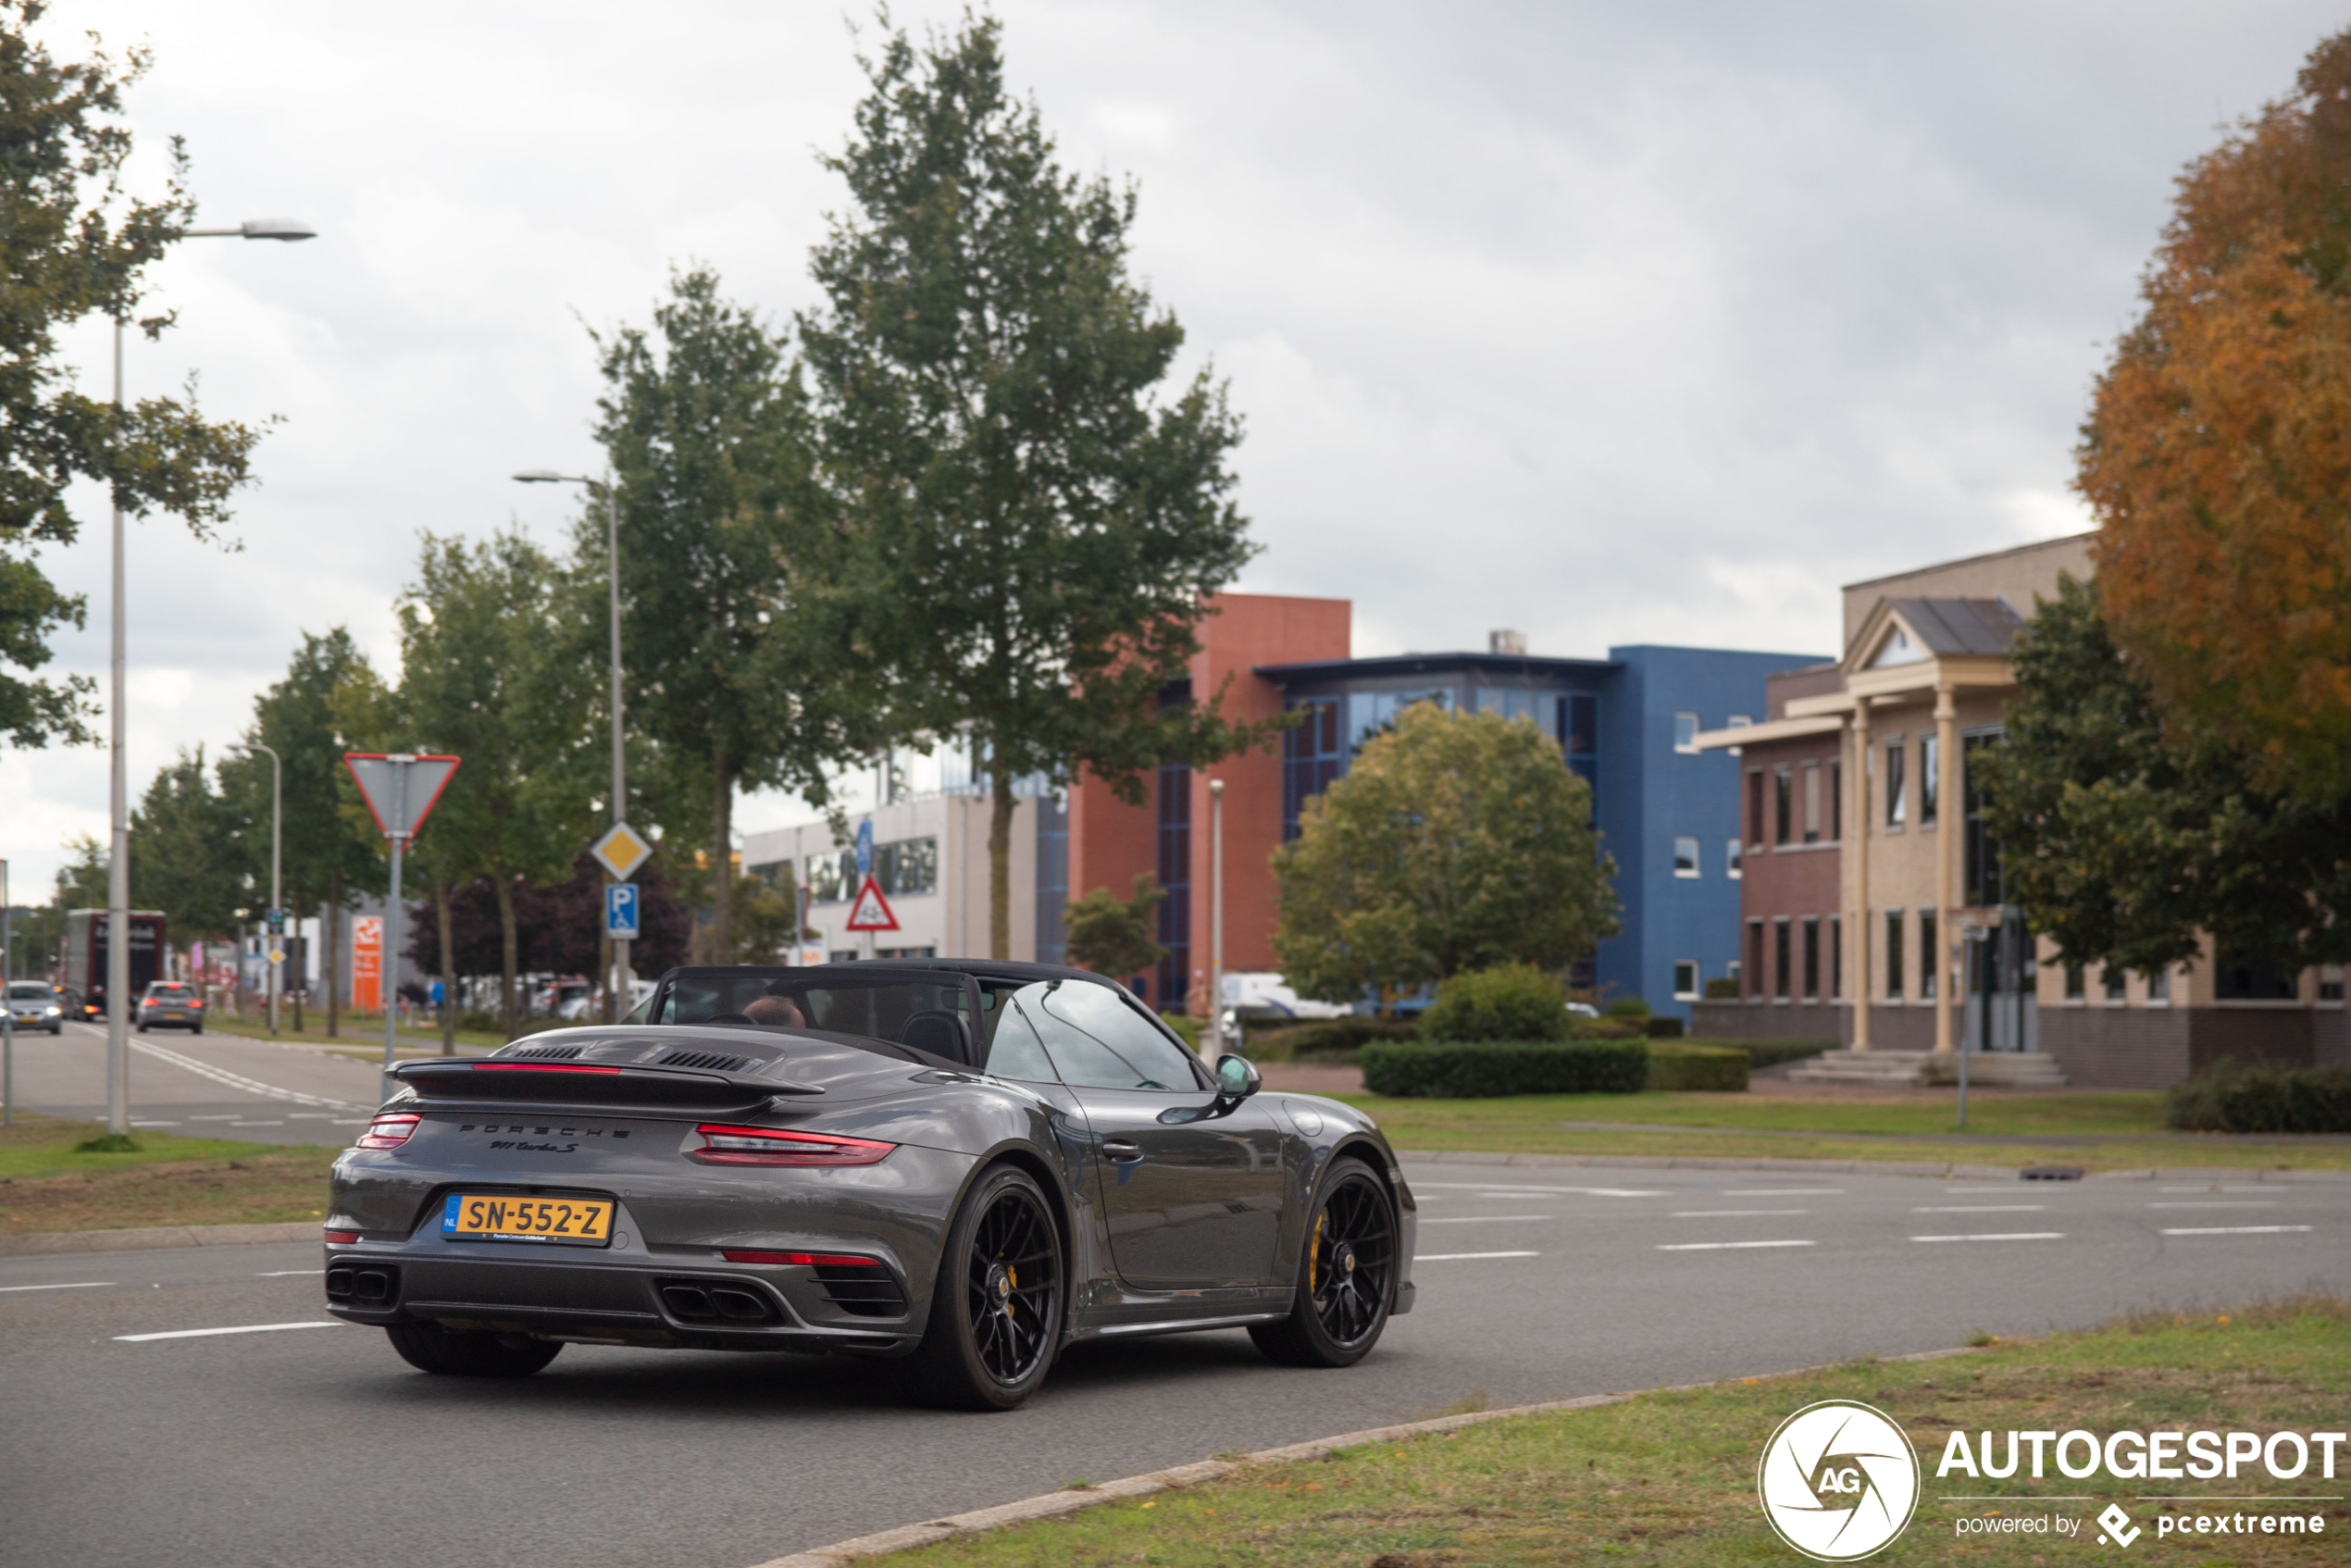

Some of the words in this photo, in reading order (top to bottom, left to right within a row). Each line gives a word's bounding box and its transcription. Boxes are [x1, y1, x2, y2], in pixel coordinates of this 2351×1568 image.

[613, 889, 632, 913] P
[459, 1125, 630, 1139] PORSCHE
[490, 1140, 516, 1150] 911
[516, 1141, 558, 1151] turbo
[555, 1143, 579, 1152] S
[444, 1218, 456, 1227] NL
[466, 1201, 601, 1235] SN-552-Z
